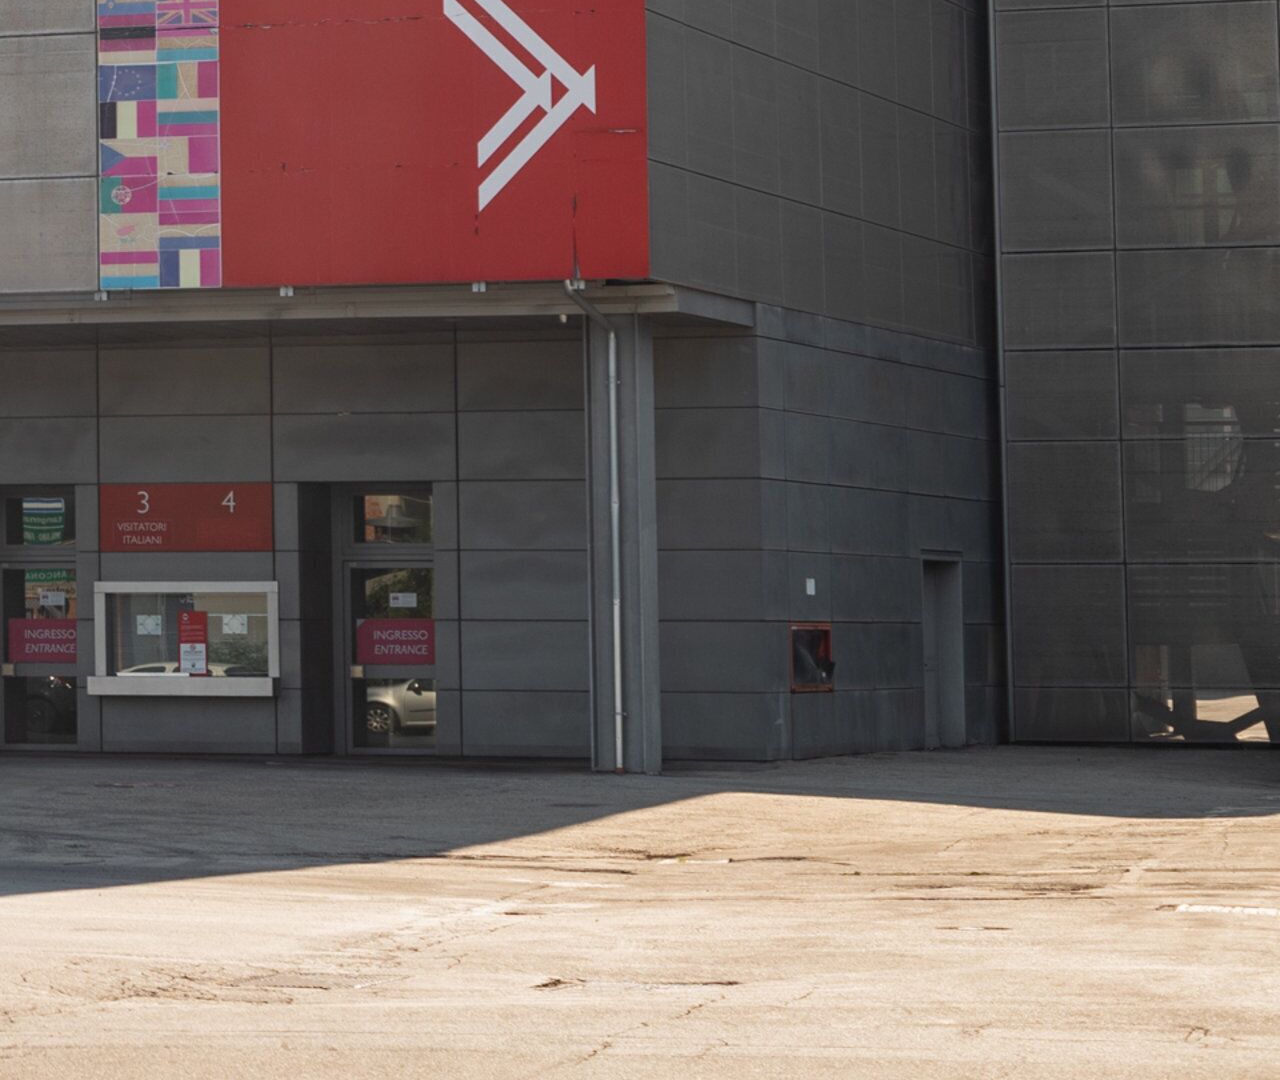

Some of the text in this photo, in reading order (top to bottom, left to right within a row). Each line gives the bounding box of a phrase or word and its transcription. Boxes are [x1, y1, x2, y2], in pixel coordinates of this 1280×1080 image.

[136, 491, 150, 514] 3
[221, 490, 236, 513] 4
[116, 522, 167, 532] VISITATORI
[122, 535, 162, 545] ITALIANI
[24, 629, 76, 639] INGRESSO
[373, 630, 429, 640] INGRESSO
[25, 643, 76, 653] ENTRANCE
[374, 644, 429, 654] ENTRANCE
